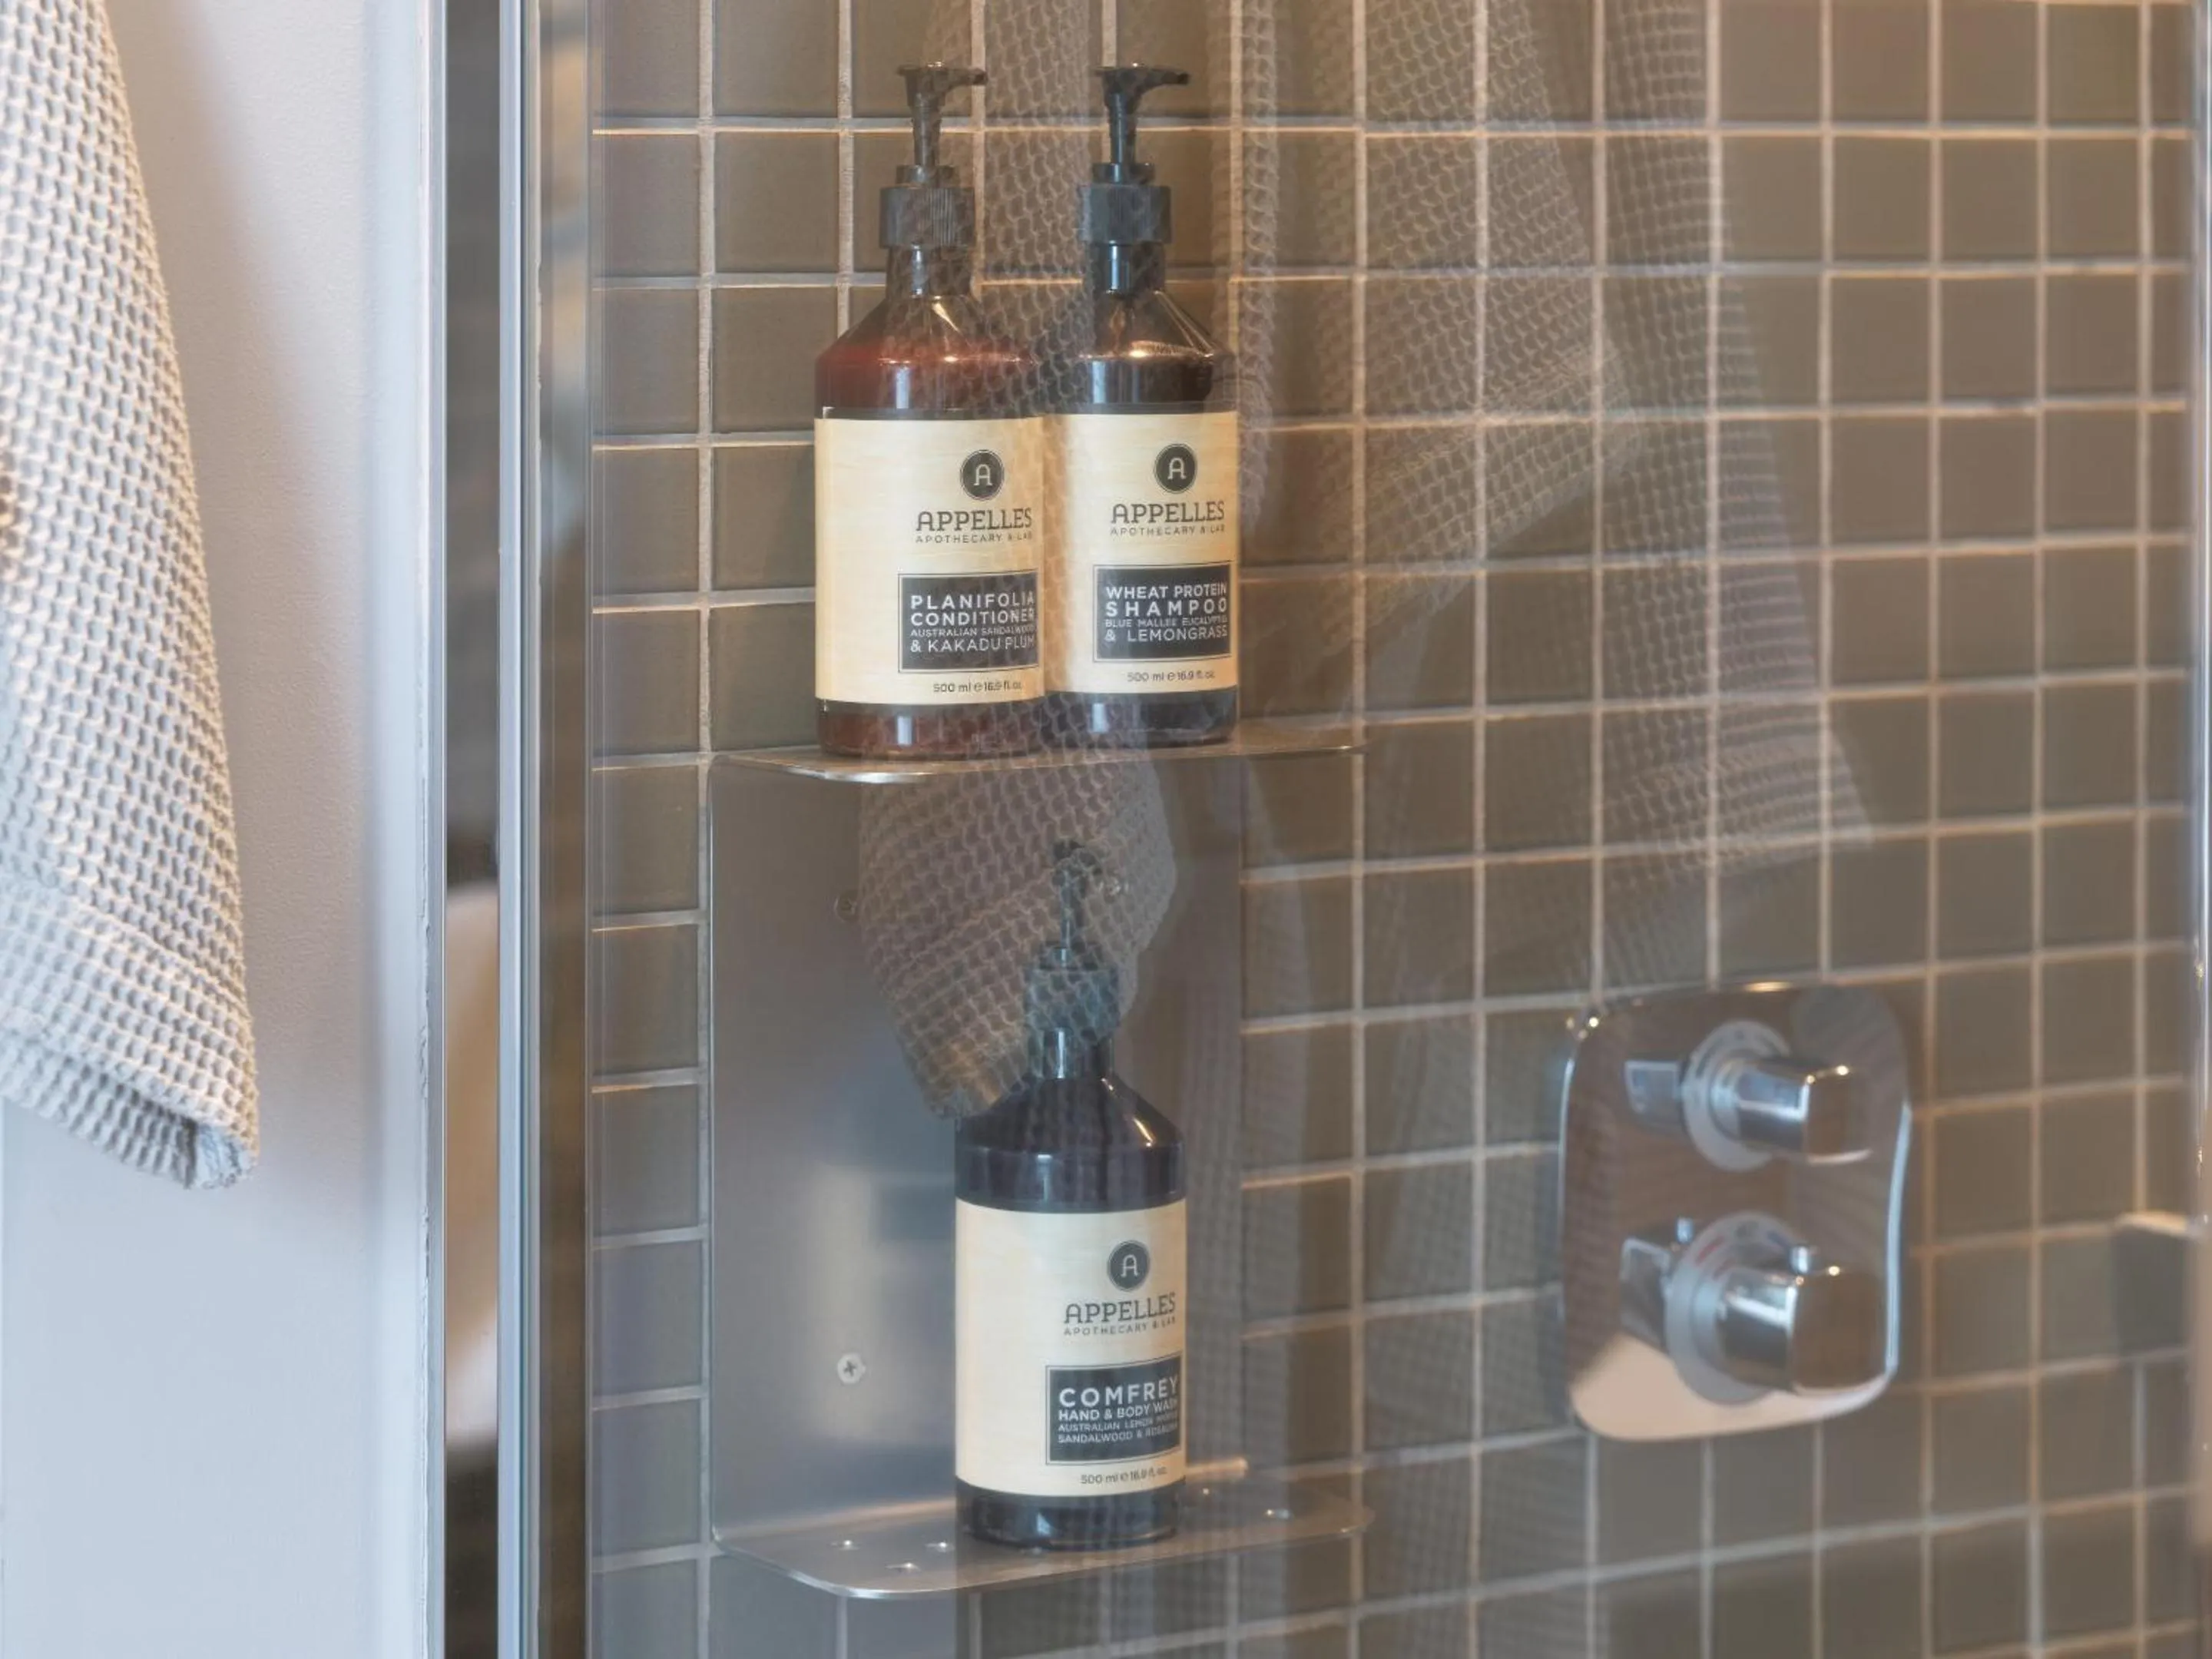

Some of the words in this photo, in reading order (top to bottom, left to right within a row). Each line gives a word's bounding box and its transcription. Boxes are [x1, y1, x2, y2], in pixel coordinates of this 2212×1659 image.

[973, 464, 992, 485] A
[1167, 458, 1187, 479] A
[916, 508, 1032, 531] APPELLES
[1111, 501, 1224, 524] APPELLES
[916, 533, 1002, 544] APOTHECARY
[1110, 525, 1196, 536] APOTHECARY
[1105, 586, 1168, 599] WHEAT
[1174, 582, 1227, 598] PROTEIN
[910, 591, 1035, 610] PLANIFOLIA
[1105, 598, 1227, 618] SHAMPOO
[910, 608, 1035, 627] CONDITIONER
[1105, 618, 1133, 628] BLUE
[910, 628, 978, 637] AUSTRALIAN
[1105, 629, 1116, 642] &
[1128, 624, 1227, 642] LEMONGRASS
[910, 640, 921, 653] &
[928, 637, 1001, 653] KAKADU
[1005, 634, 1035, 650] PLUM
[1127, 671, 1149, 682] 500
[933, 682, 955, 693] 500
[1121, 1254, 1140, 1278] A
[1064, 1292, 1176, 1323] APPELLES
[1064, 1323, 1147, 1336] APOTHECARY
[1059, 1376, 1177, 1407] COMFREY
[1058, 1409, 1099, 1421] HAND
[1104, 1409, 1113, 1419] &
[1118, 1404, 1151, 1419] BODY
[1058, 1421, 1120, 1432] AUSTRALIAN
[1058, 1432, 1133, 1444] SANDALWOOD
[1081, 1474, 1102, 1485] 500
